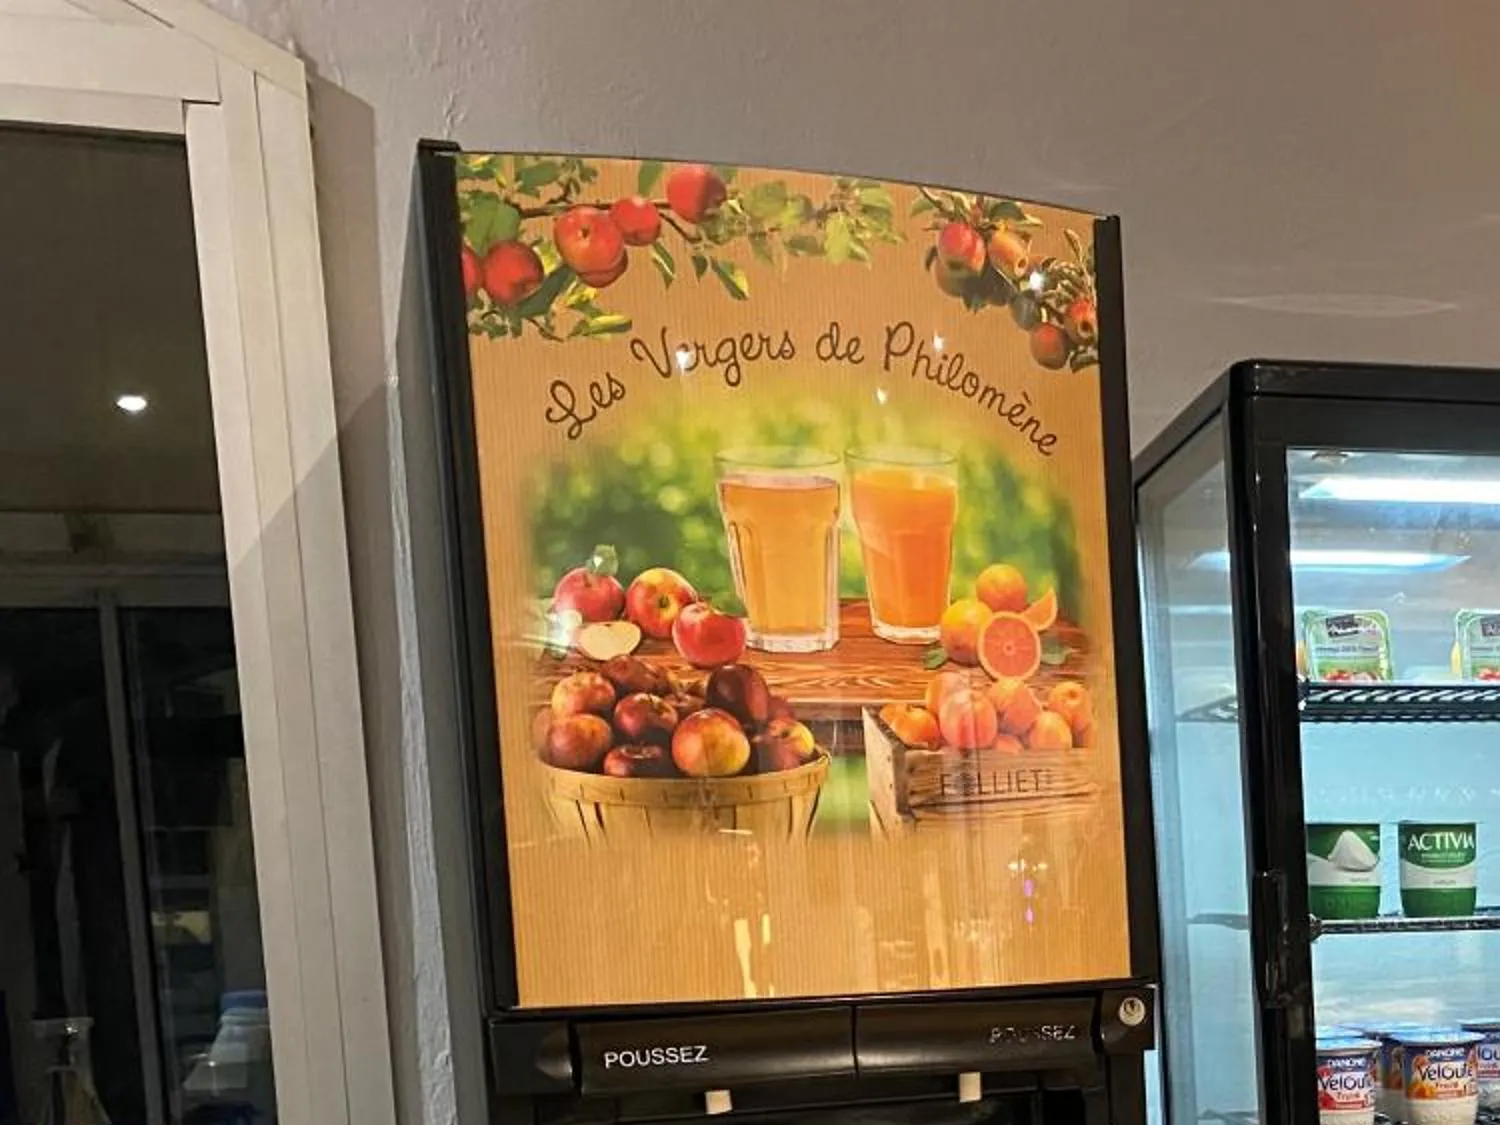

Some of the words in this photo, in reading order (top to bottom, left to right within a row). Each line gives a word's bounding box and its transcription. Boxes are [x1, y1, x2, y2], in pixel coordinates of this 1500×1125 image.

[544, 370, 628, 441] Les
[814, 320, 865, 365] de
[883, 320, 1059, 458] Philomène
[988, 1024, 1078, 1044] PSEZ
[603, 1044, 710, 1070] POUSSEZ
